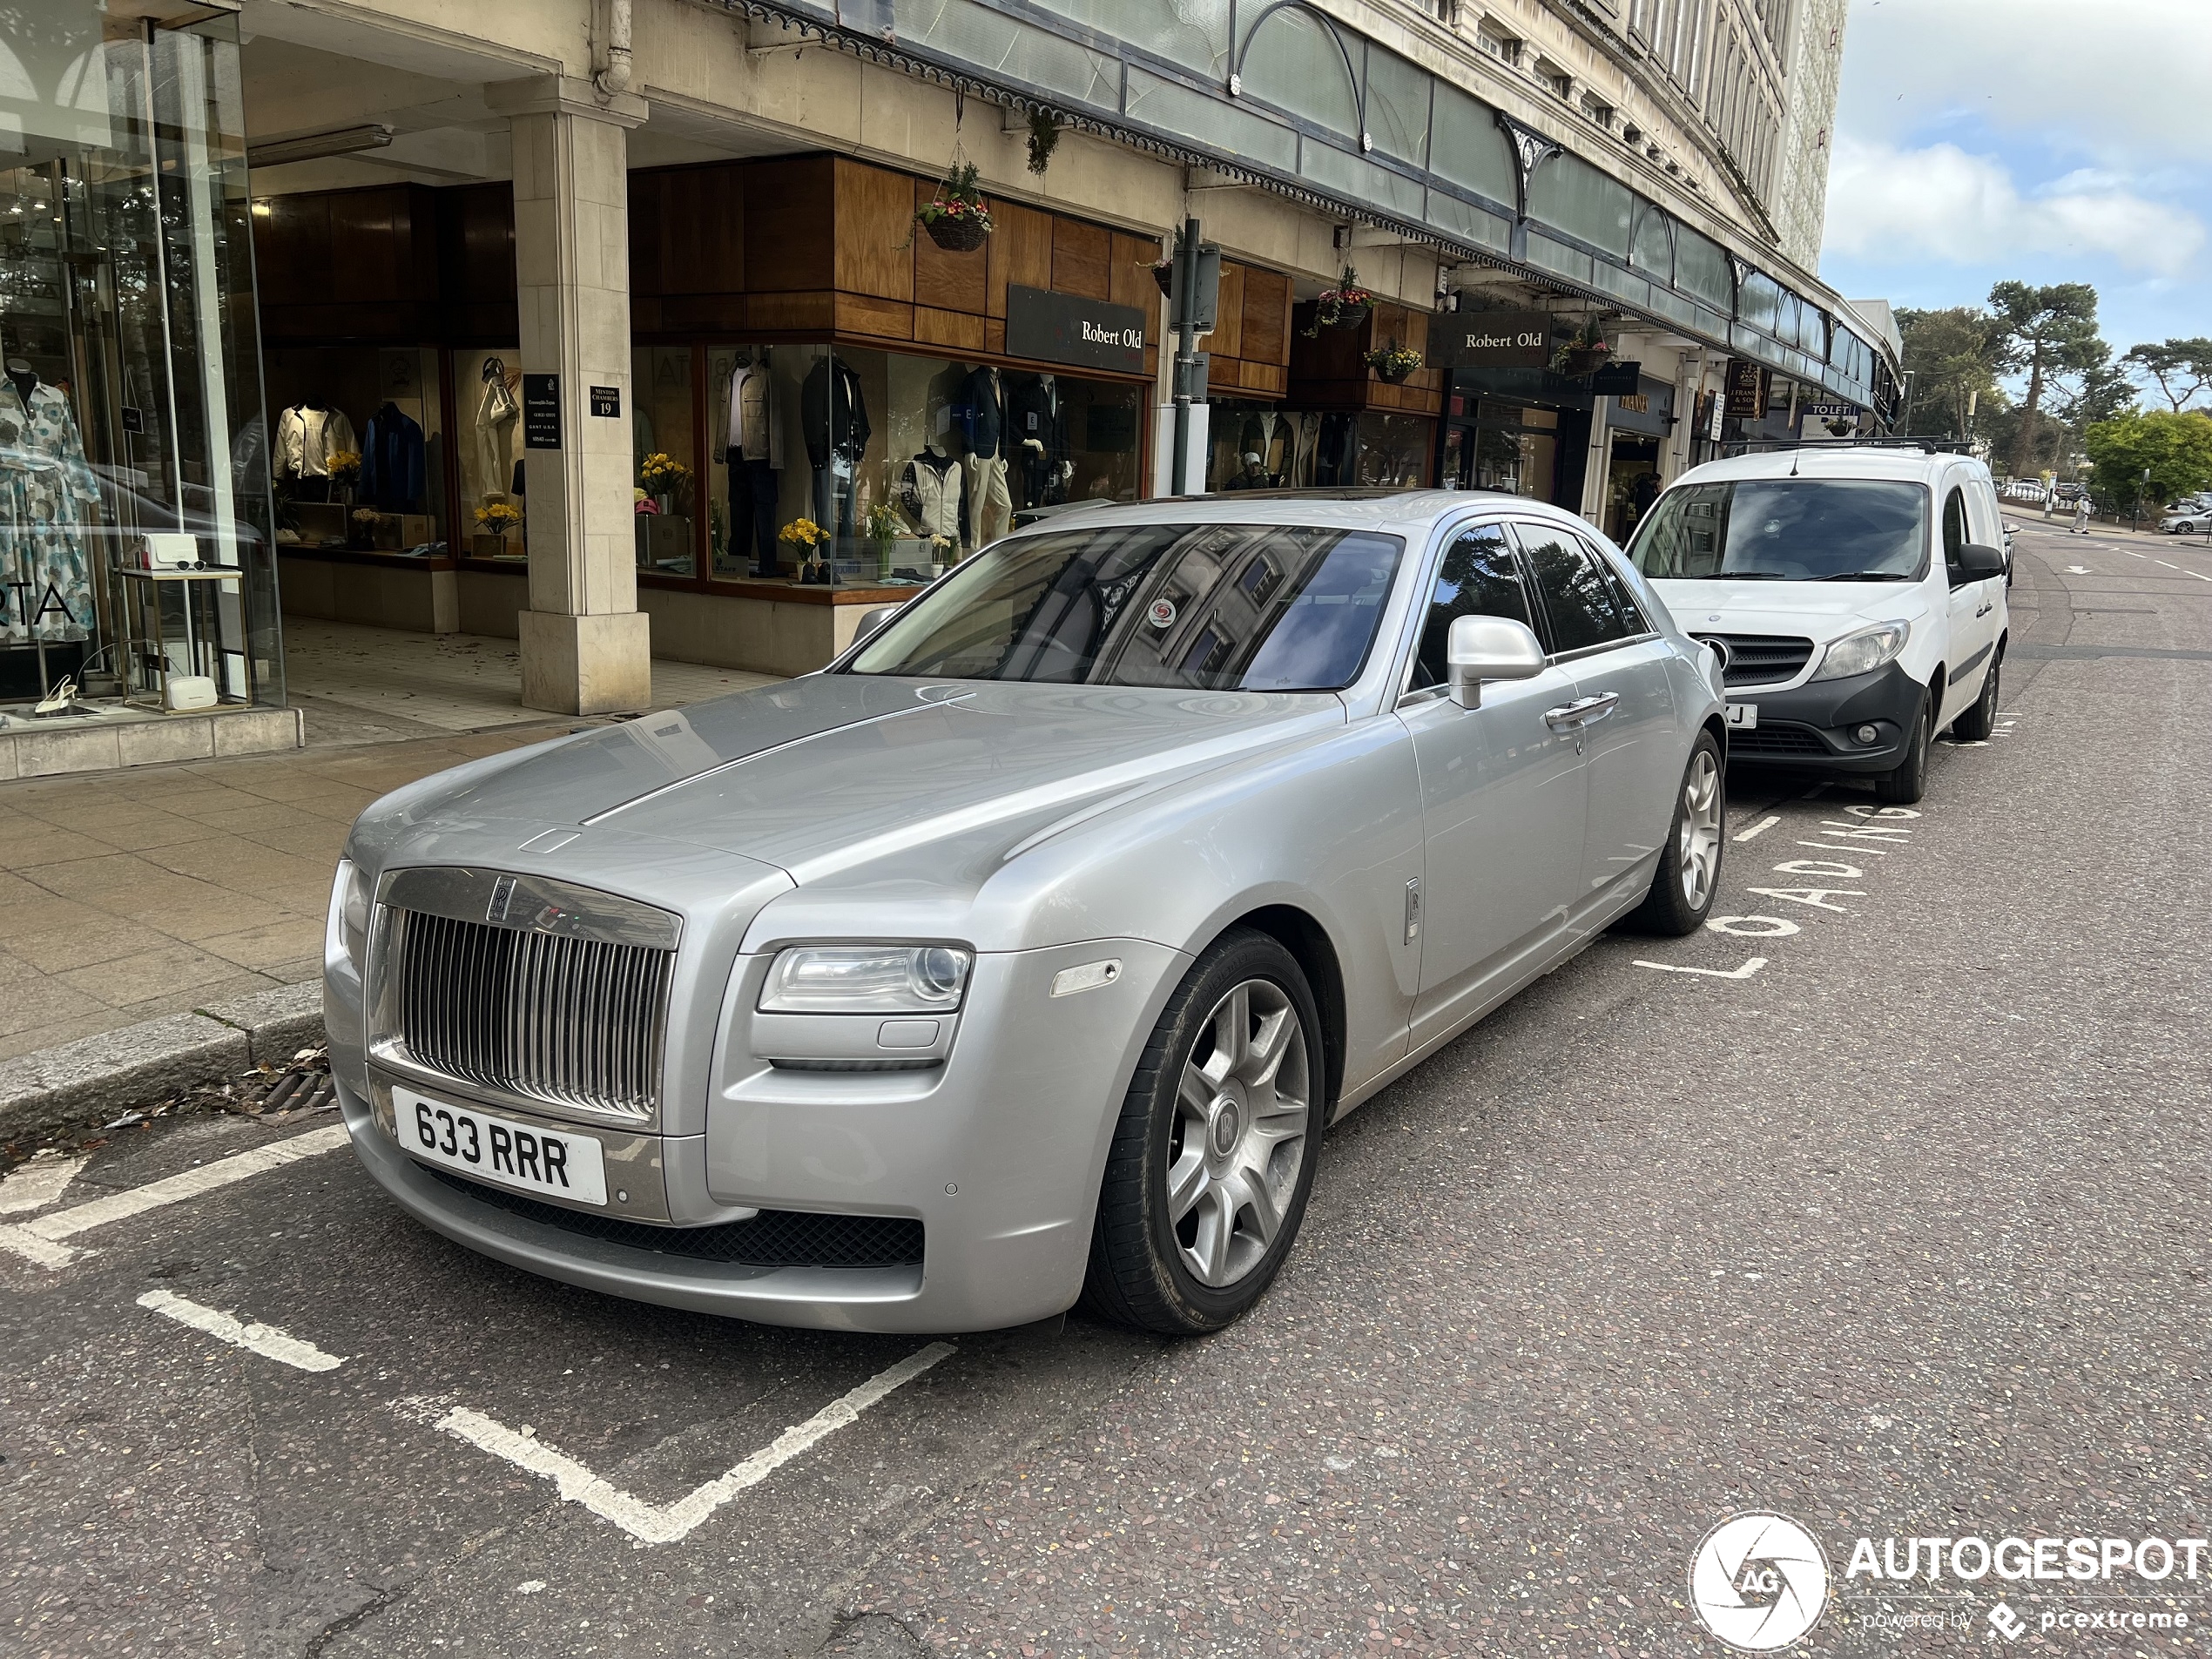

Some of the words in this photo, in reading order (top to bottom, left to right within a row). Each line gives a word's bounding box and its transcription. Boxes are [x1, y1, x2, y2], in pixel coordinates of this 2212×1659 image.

[1082, 320, 1119, 345] Robert
[1123, 328, 1142, 348] Old
[1466, 334, 1512, 347] Robert
[1517, 332, 1542, 347] Old
[600, 402, 611, 415] 19
[1812, 405, 1828, 415] TO
[1830, 406, 1849, 415] LET
[1631, 805, 1922, 979] LOADING
[415, 1102, 481, 1164] 633
[489, 1123, 570, 1188] RRR
